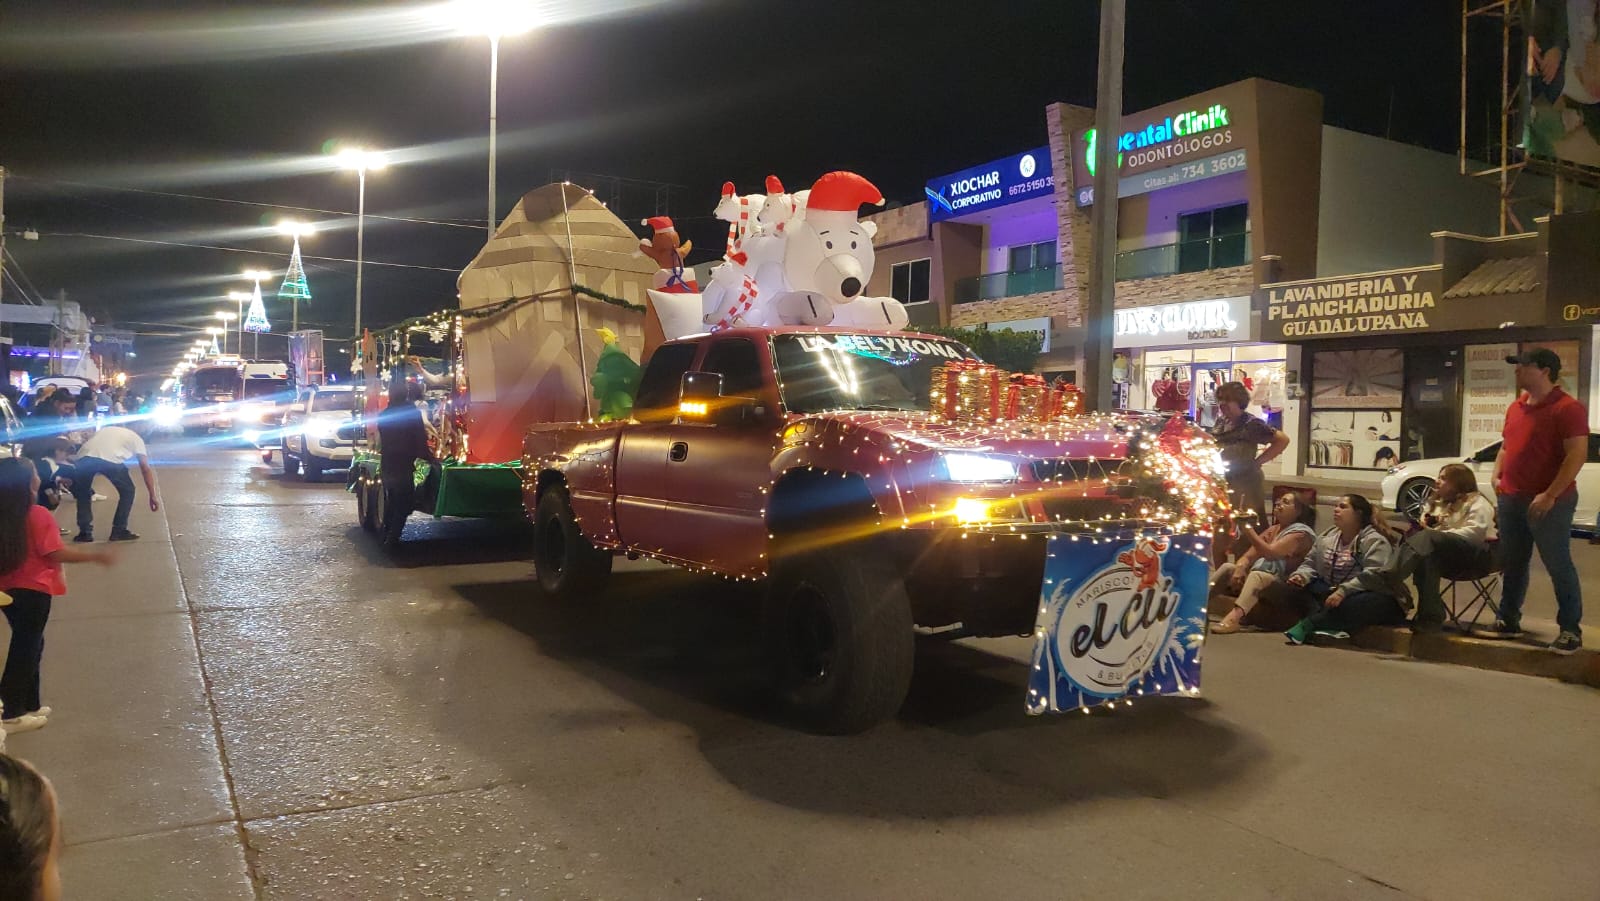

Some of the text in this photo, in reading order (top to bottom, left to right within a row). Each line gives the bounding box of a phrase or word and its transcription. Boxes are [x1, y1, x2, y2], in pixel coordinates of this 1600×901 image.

[1173, 104, 1230, 137] Clinik
[1128, 130, 1232, 168] ODONTÓLOGOS
[1182, 163, 1205, 178] 734
[1211, 153, 1246, 174] 3602
[950, 171, 1000, 197] XIOCHAR
[1008, 184, 1026, 196] 6672
[1027, 178, 1046, 192] 5150
[951, 188, 1002, 210] CORPORATIVO
[1269, 274, 1418, 304] LAVANDERIA Y
[1268, 292, 1435, 320] PLANCHADURIA
[1187, 329, 1229, 340] BOUTIQUE
[1282, 312, 1430, 336] GUADALUPANA
[1070, 602, 1119, 658] el
